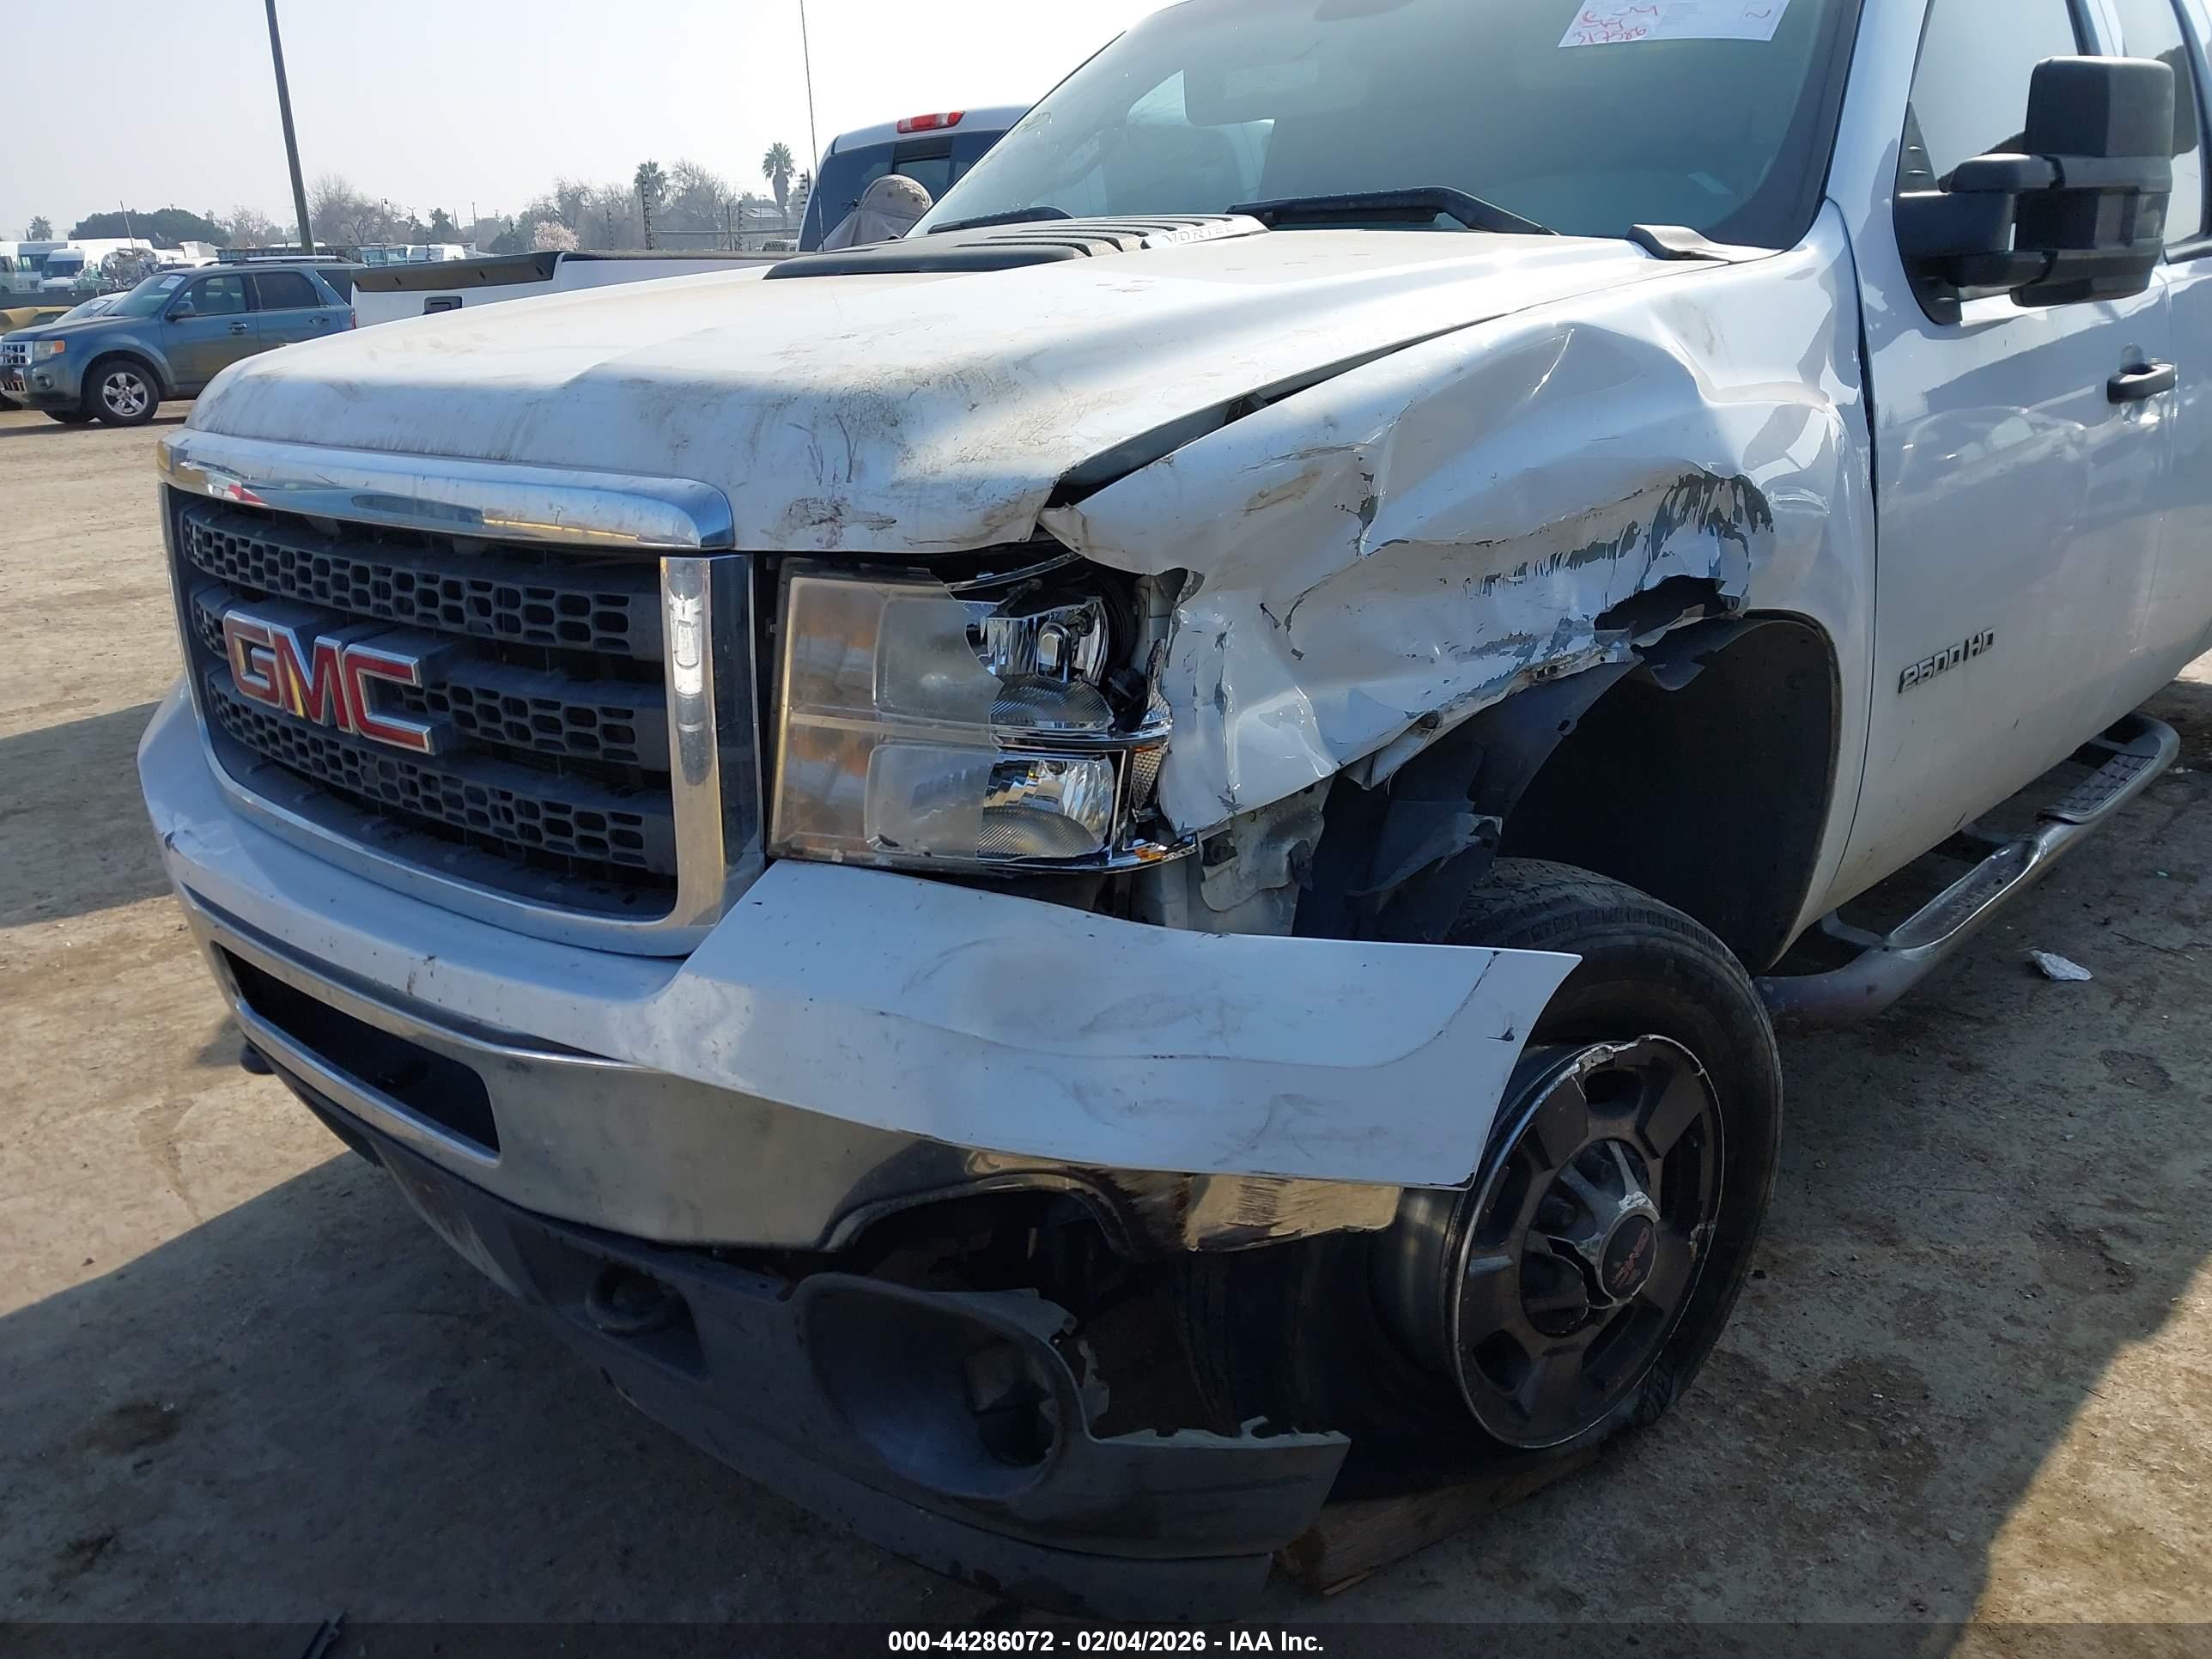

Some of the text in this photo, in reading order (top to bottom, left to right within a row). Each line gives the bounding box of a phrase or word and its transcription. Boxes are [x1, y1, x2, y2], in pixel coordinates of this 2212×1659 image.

[222, 610, 434, 755] GMC
[1898, 626, 1994, 694] 2500 HD
